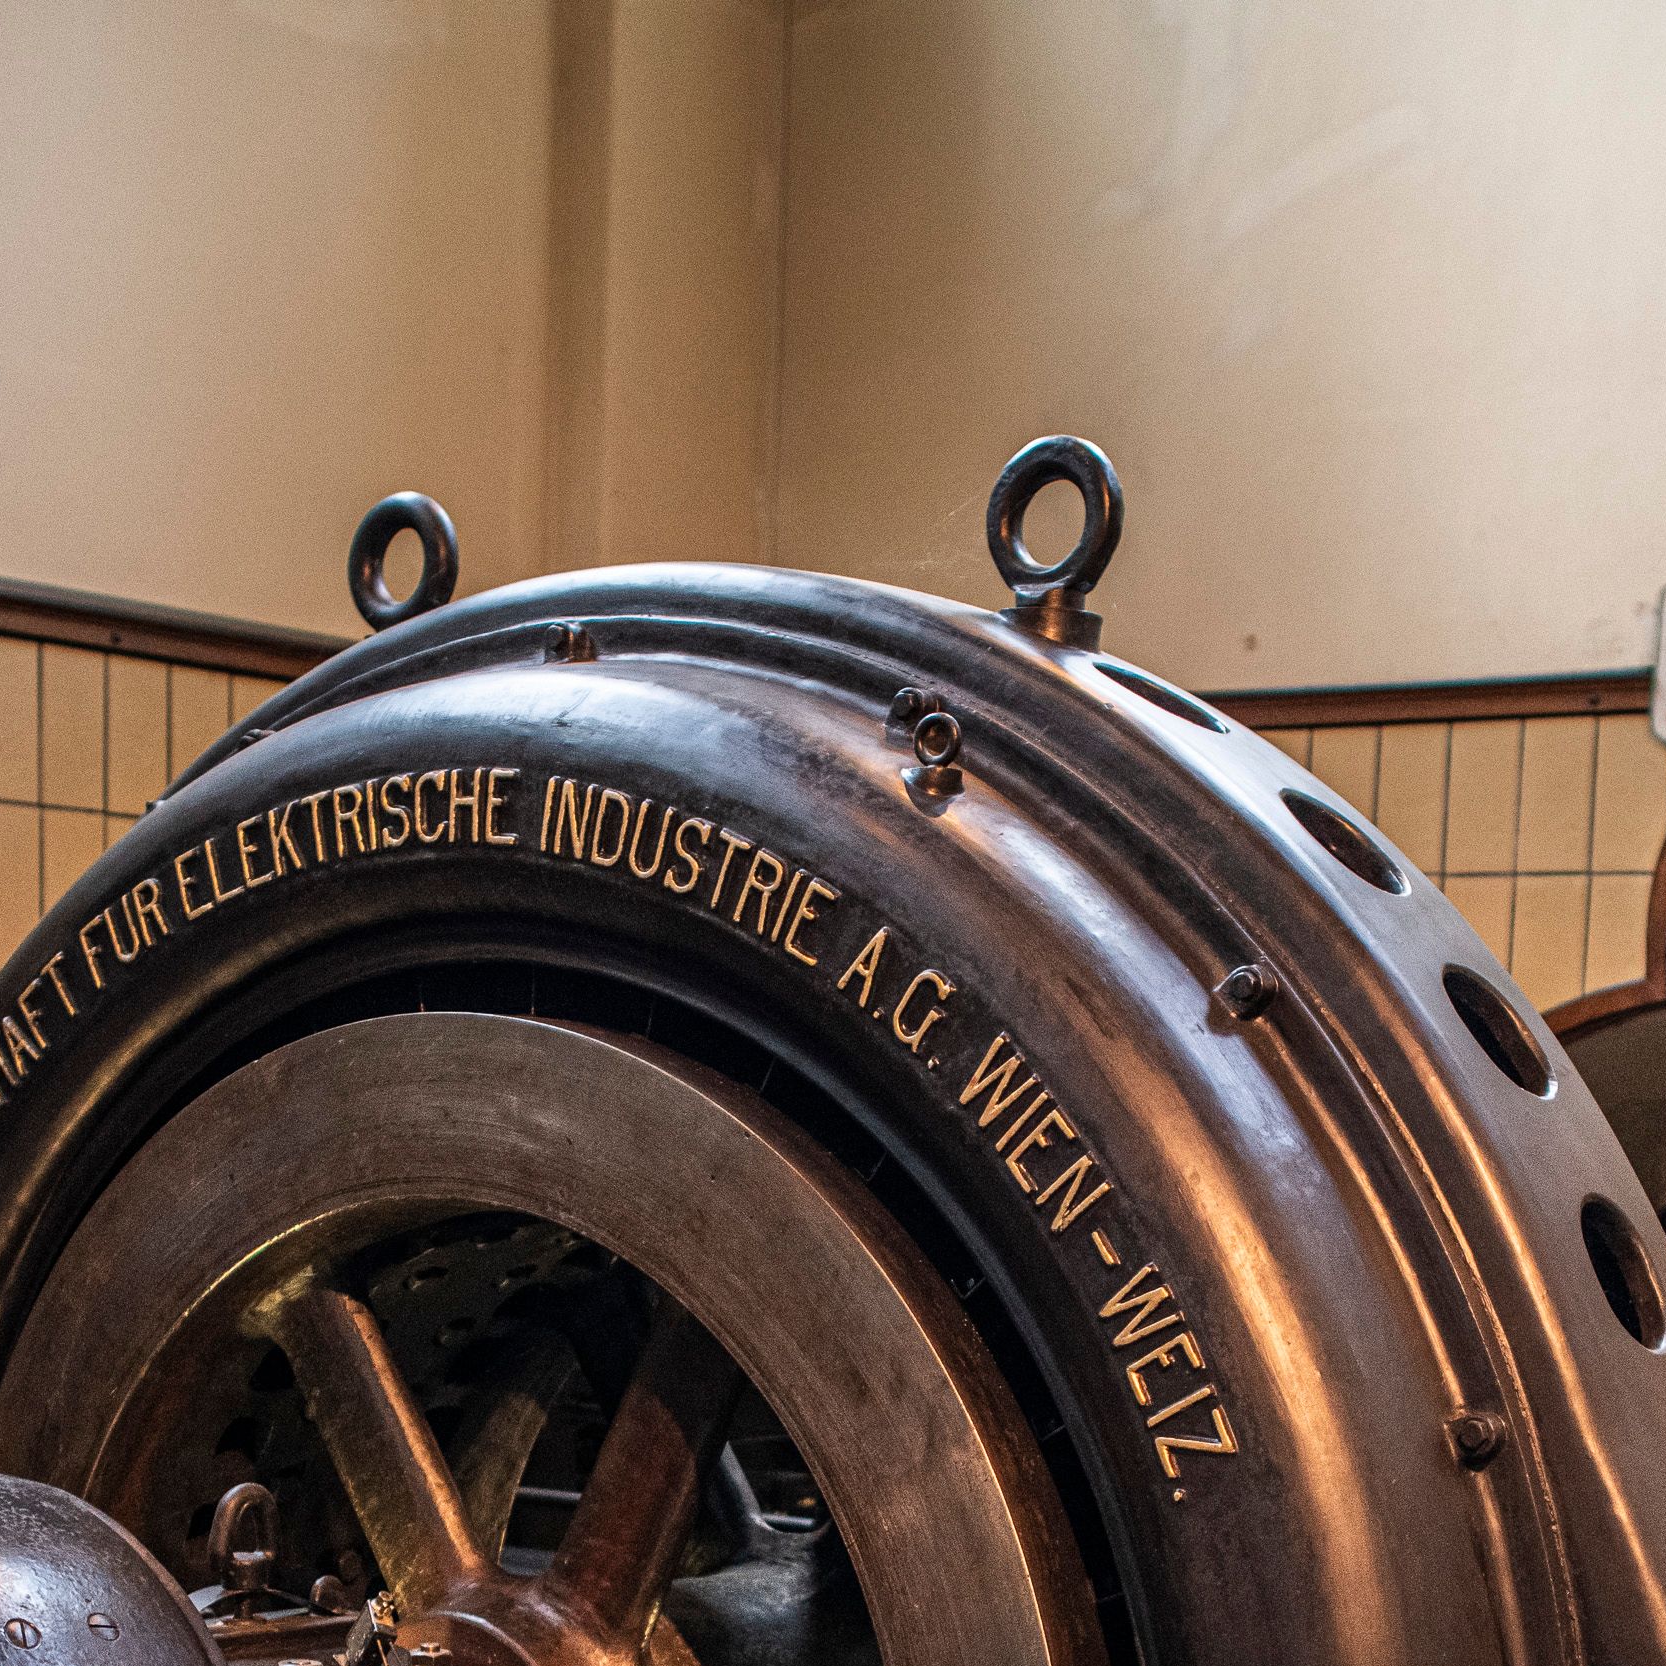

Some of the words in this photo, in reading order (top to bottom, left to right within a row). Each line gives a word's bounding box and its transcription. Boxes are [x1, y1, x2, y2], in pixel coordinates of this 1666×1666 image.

[174, 768, 521, 921] ELEKTRISCHE
[540, 775, 843, 966] INDUSTRIE
[837, 926, 956, 1069] A.G.
